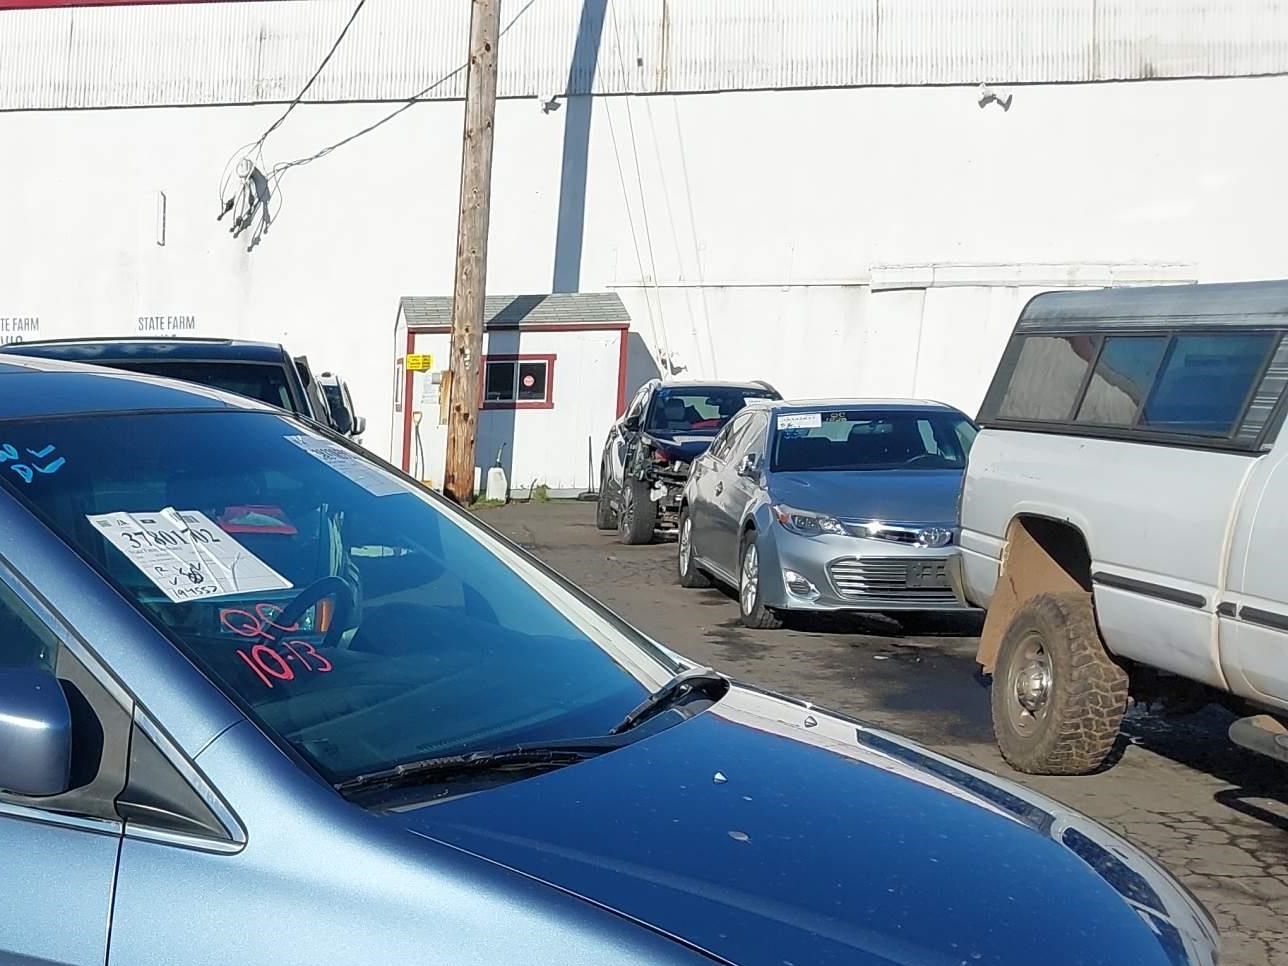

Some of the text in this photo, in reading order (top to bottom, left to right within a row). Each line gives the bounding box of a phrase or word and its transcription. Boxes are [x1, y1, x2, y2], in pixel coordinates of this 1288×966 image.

[12, 317, 39, 332] FARM
[138, 316, 195, 331] STATE FARM
